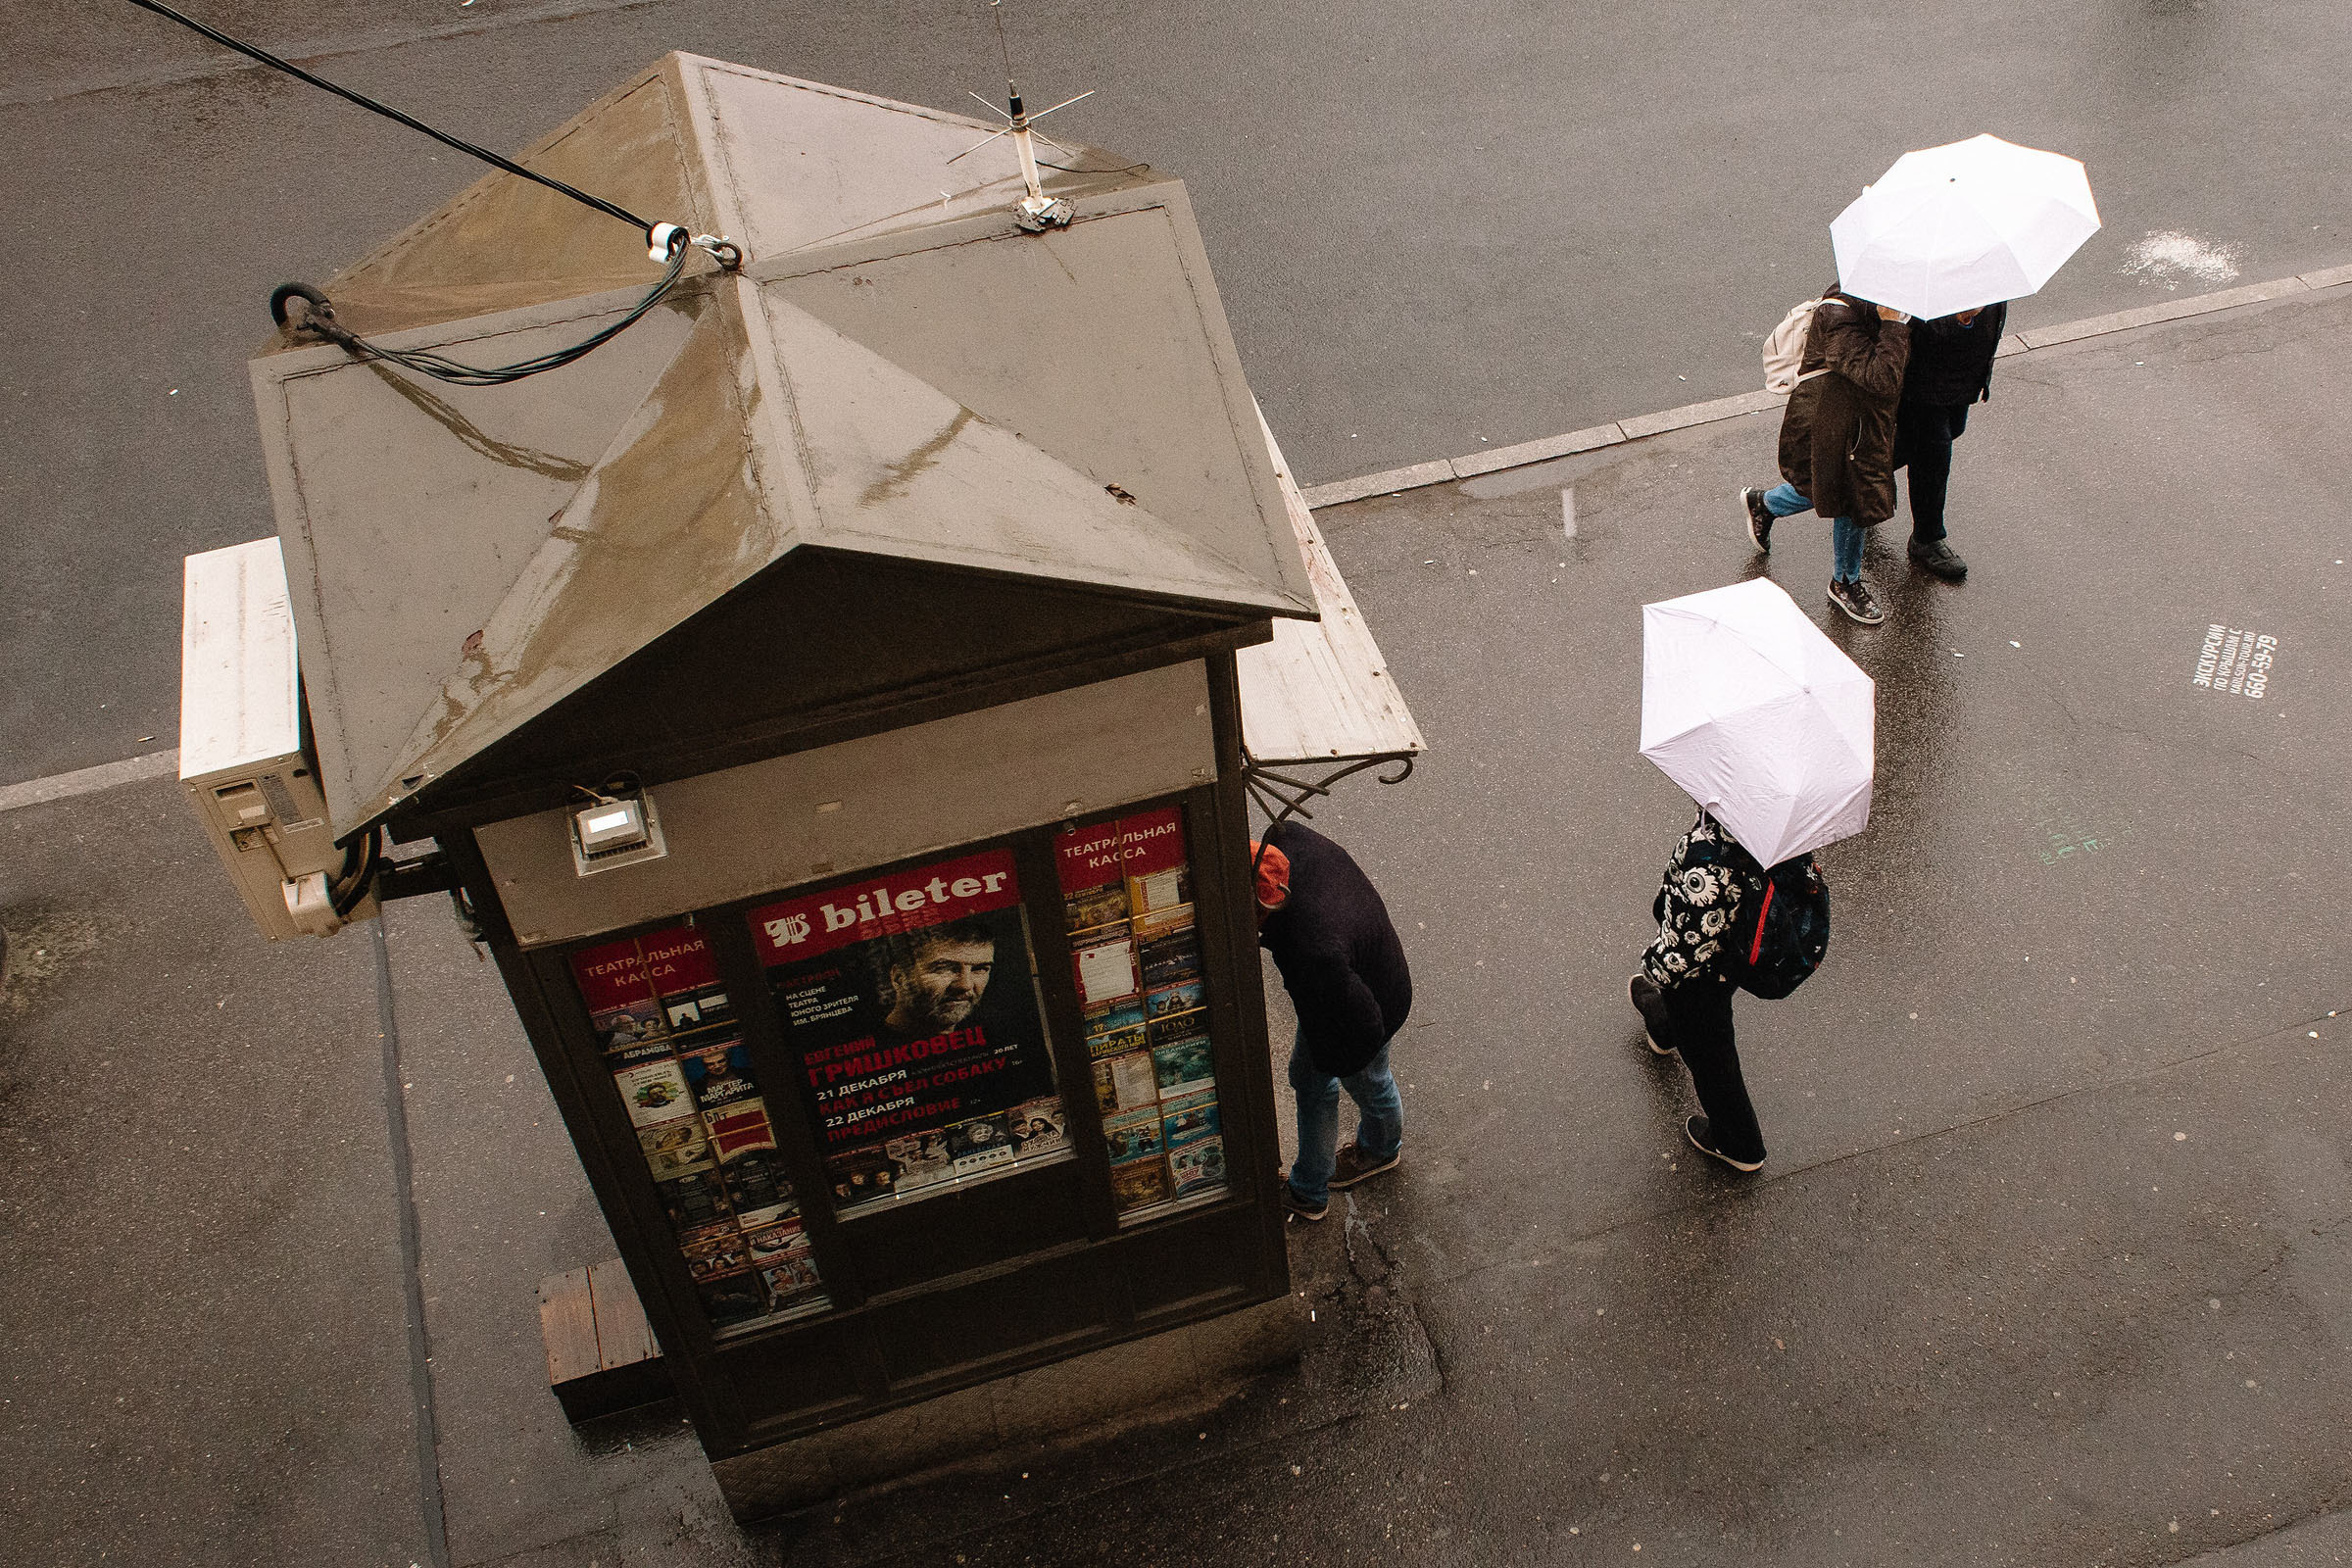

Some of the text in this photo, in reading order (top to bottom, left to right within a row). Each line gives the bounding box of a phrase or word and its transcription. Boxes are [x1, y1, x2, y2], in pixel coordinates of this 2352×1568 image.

[2193, 623, 2227, 688] ЭКСКУРСИИ
[2217, 635, 2240, 677] КРЫШАМ
[2244, 634, 2278, 699] 660-59-79
[2213, 678, 2229, 691] ПО
[1063, 821, 1176, 858] ТЕАТРАЛЬНАЯ
[1089, 847, 1147, 869] КАССА
[819, 871, 1007, 933] bileter
[584, 939, 706, 978] ТЕАТРАЛЬНАЯ
[613, 964, 676, 988] КАССА
[786, 985, 827, 1002] НА СЦЕНЕ
[788, 996, 819, 1009] ТЕАТРА
[790, 995, 859, 1018] ЮНОГО ЗРИТЕЛЯ
[810, 1006, 854, 1024] БРЯНЦЕВА
[808, 1025, 988, 1088] ГРИШКОВЕЦ
[1090, 1033, 1146, 1054] ПИРАТЫ
[816, 1069, 907, 1102] 21 ДЕКАБРЯ
[818, 1097, 858, 1116] КАК
[861, 1092, 875, 1104] Я
[878, 1079, 929, 1100] СЪЕЛ
[933, 1055, 1007, 1087] СОБАКУ
[825, 1097, 916, 1128] 22 ДЕКАБРЯ
[826, 1098, 962, 1144] ПРЕДИСЛОВИЕ
